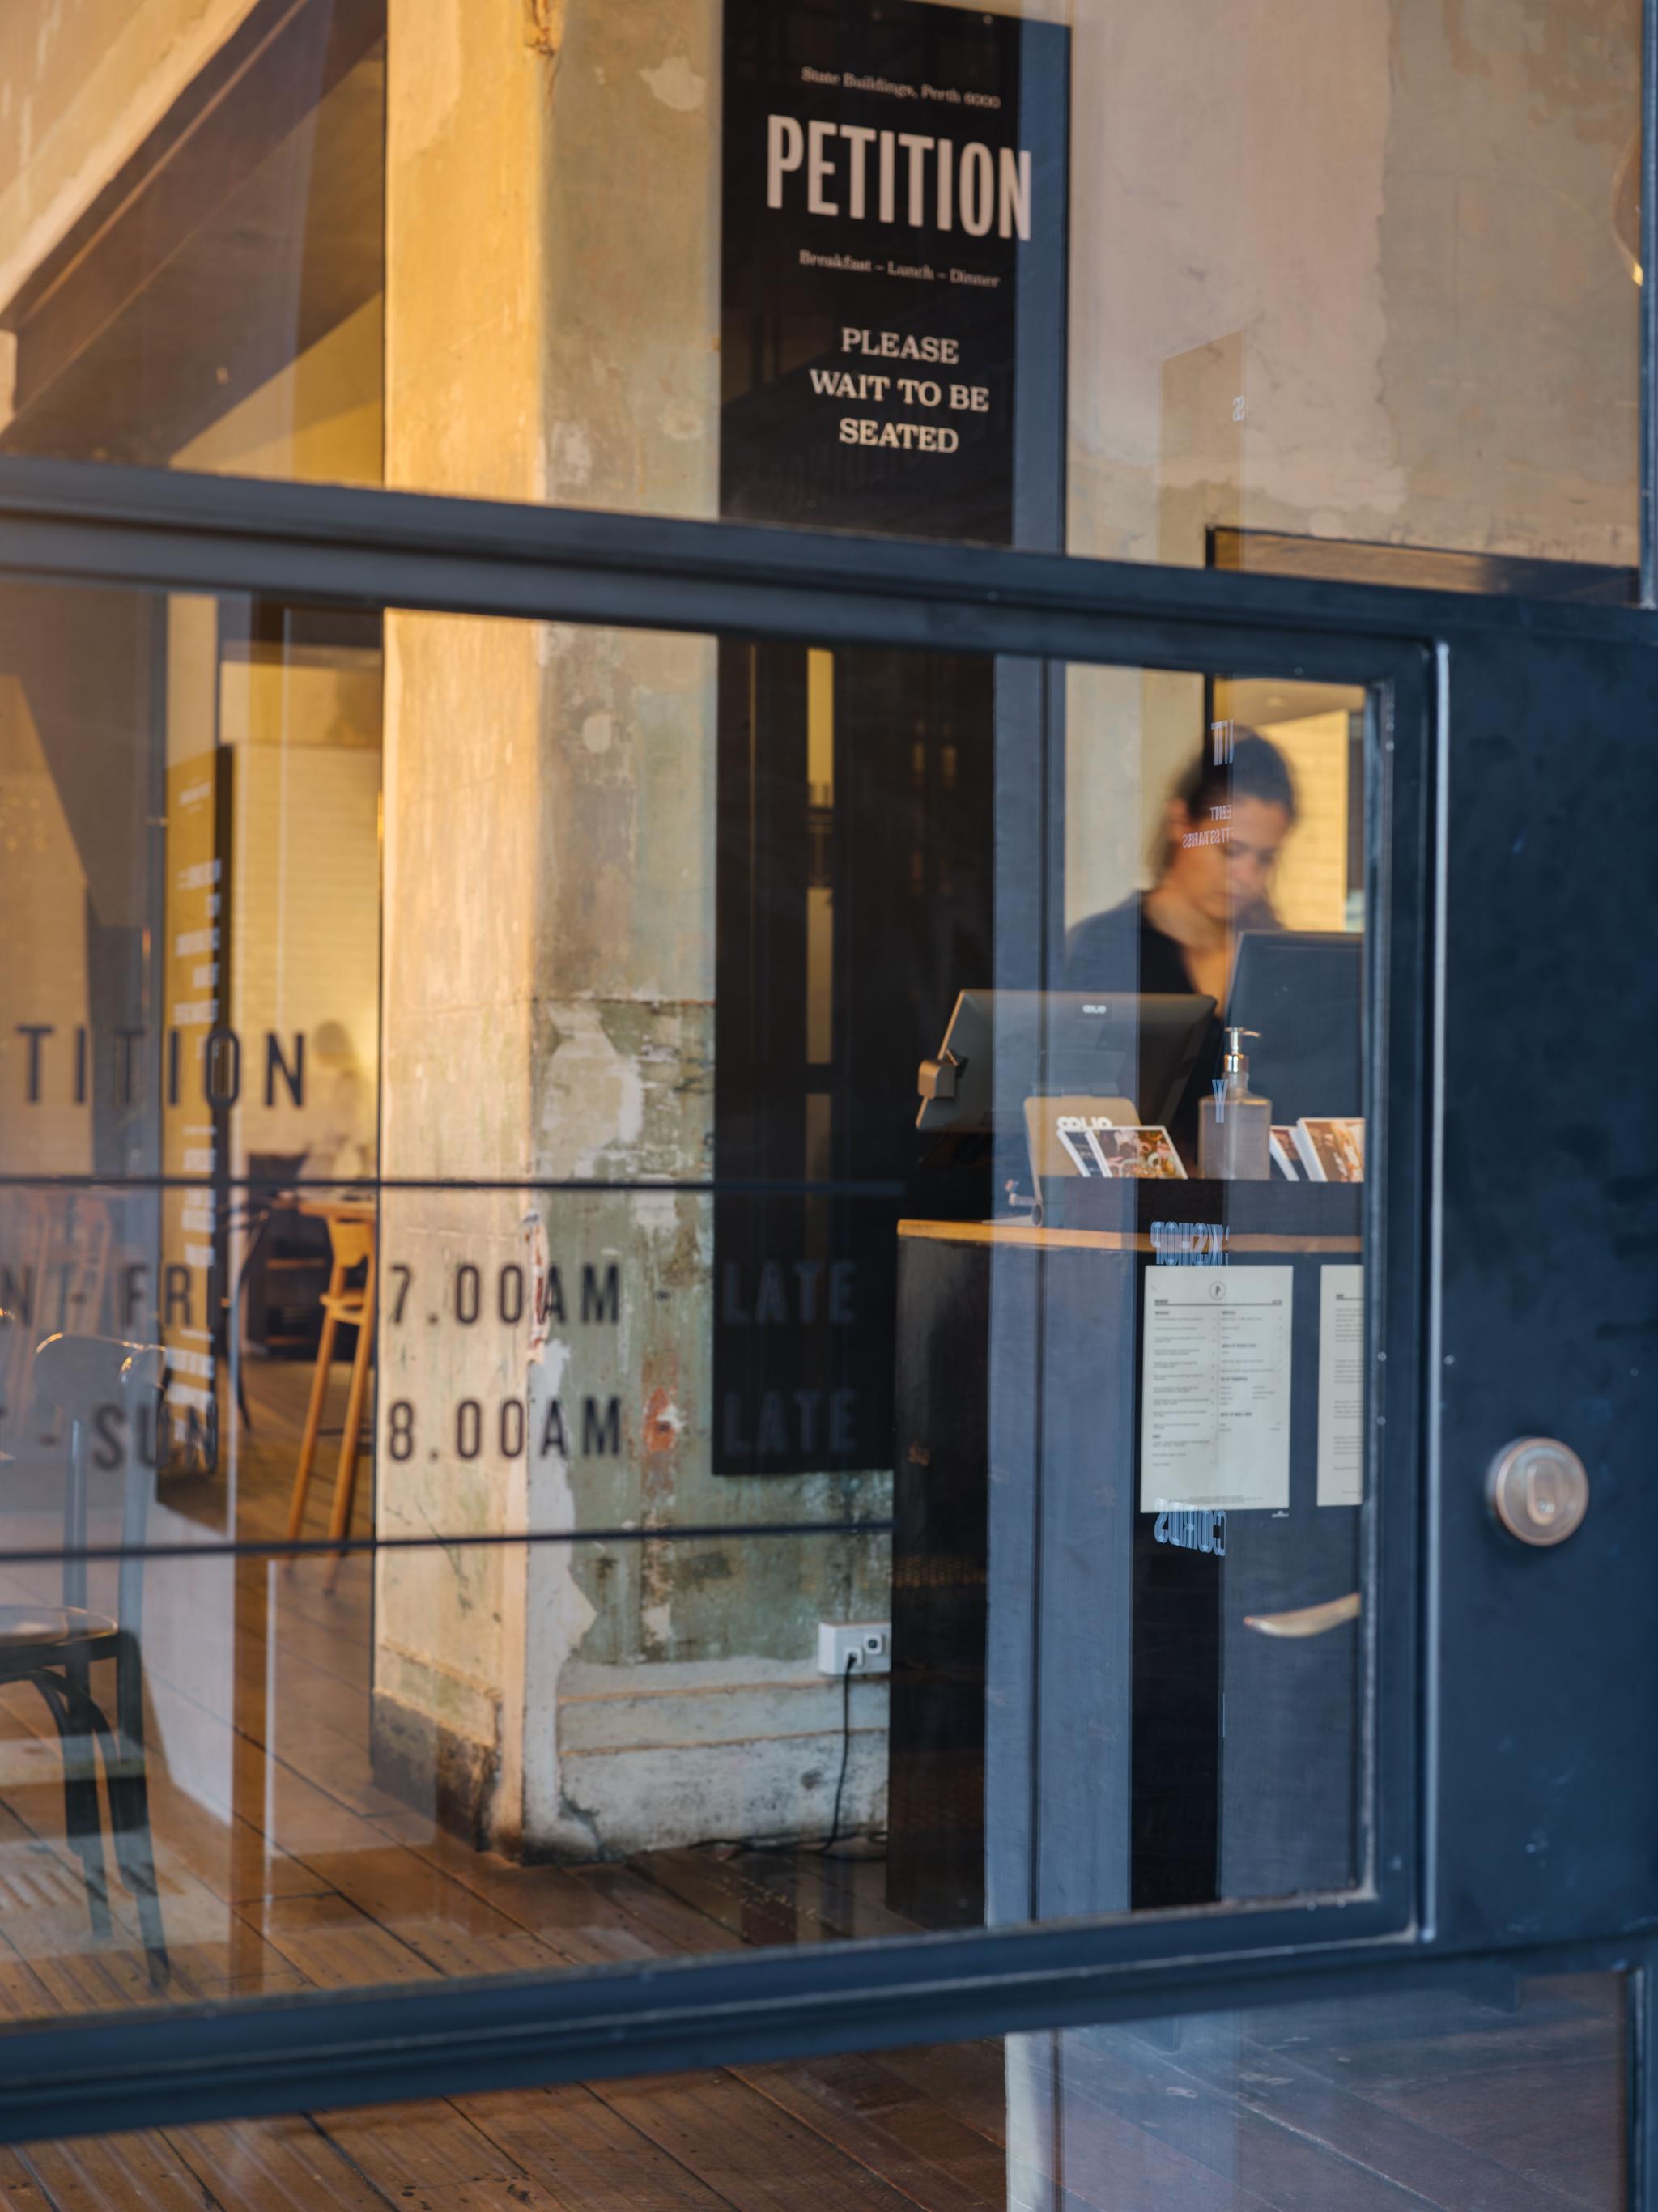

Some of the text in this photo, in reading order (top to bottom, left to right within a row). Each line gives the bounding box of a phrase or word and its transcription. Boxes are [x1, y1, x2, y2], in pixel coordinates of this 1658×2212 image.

[921, 83, 962, 104] Perth
[767, 114, 1031, 241] PETITION
[799, 249, 872, 273] Breakfast
[887, 260, 934, 281] Lunch
[949, 268, 1001, 288] Dinner
[841, 326, 959, 364] PLEASE
[810, 368, 990, 413] WAIT TO BE
[839, 418, 959, 454] SEATED
[387, 1262, 622, 1326] 7.00AM
[721, 1259, 857, 1326] LATE
[91, 1402, 219, 1475] SUN
[387, 1395, 622, 1462] 8.00AM
[721, 1386, 857, 1457] LATE
